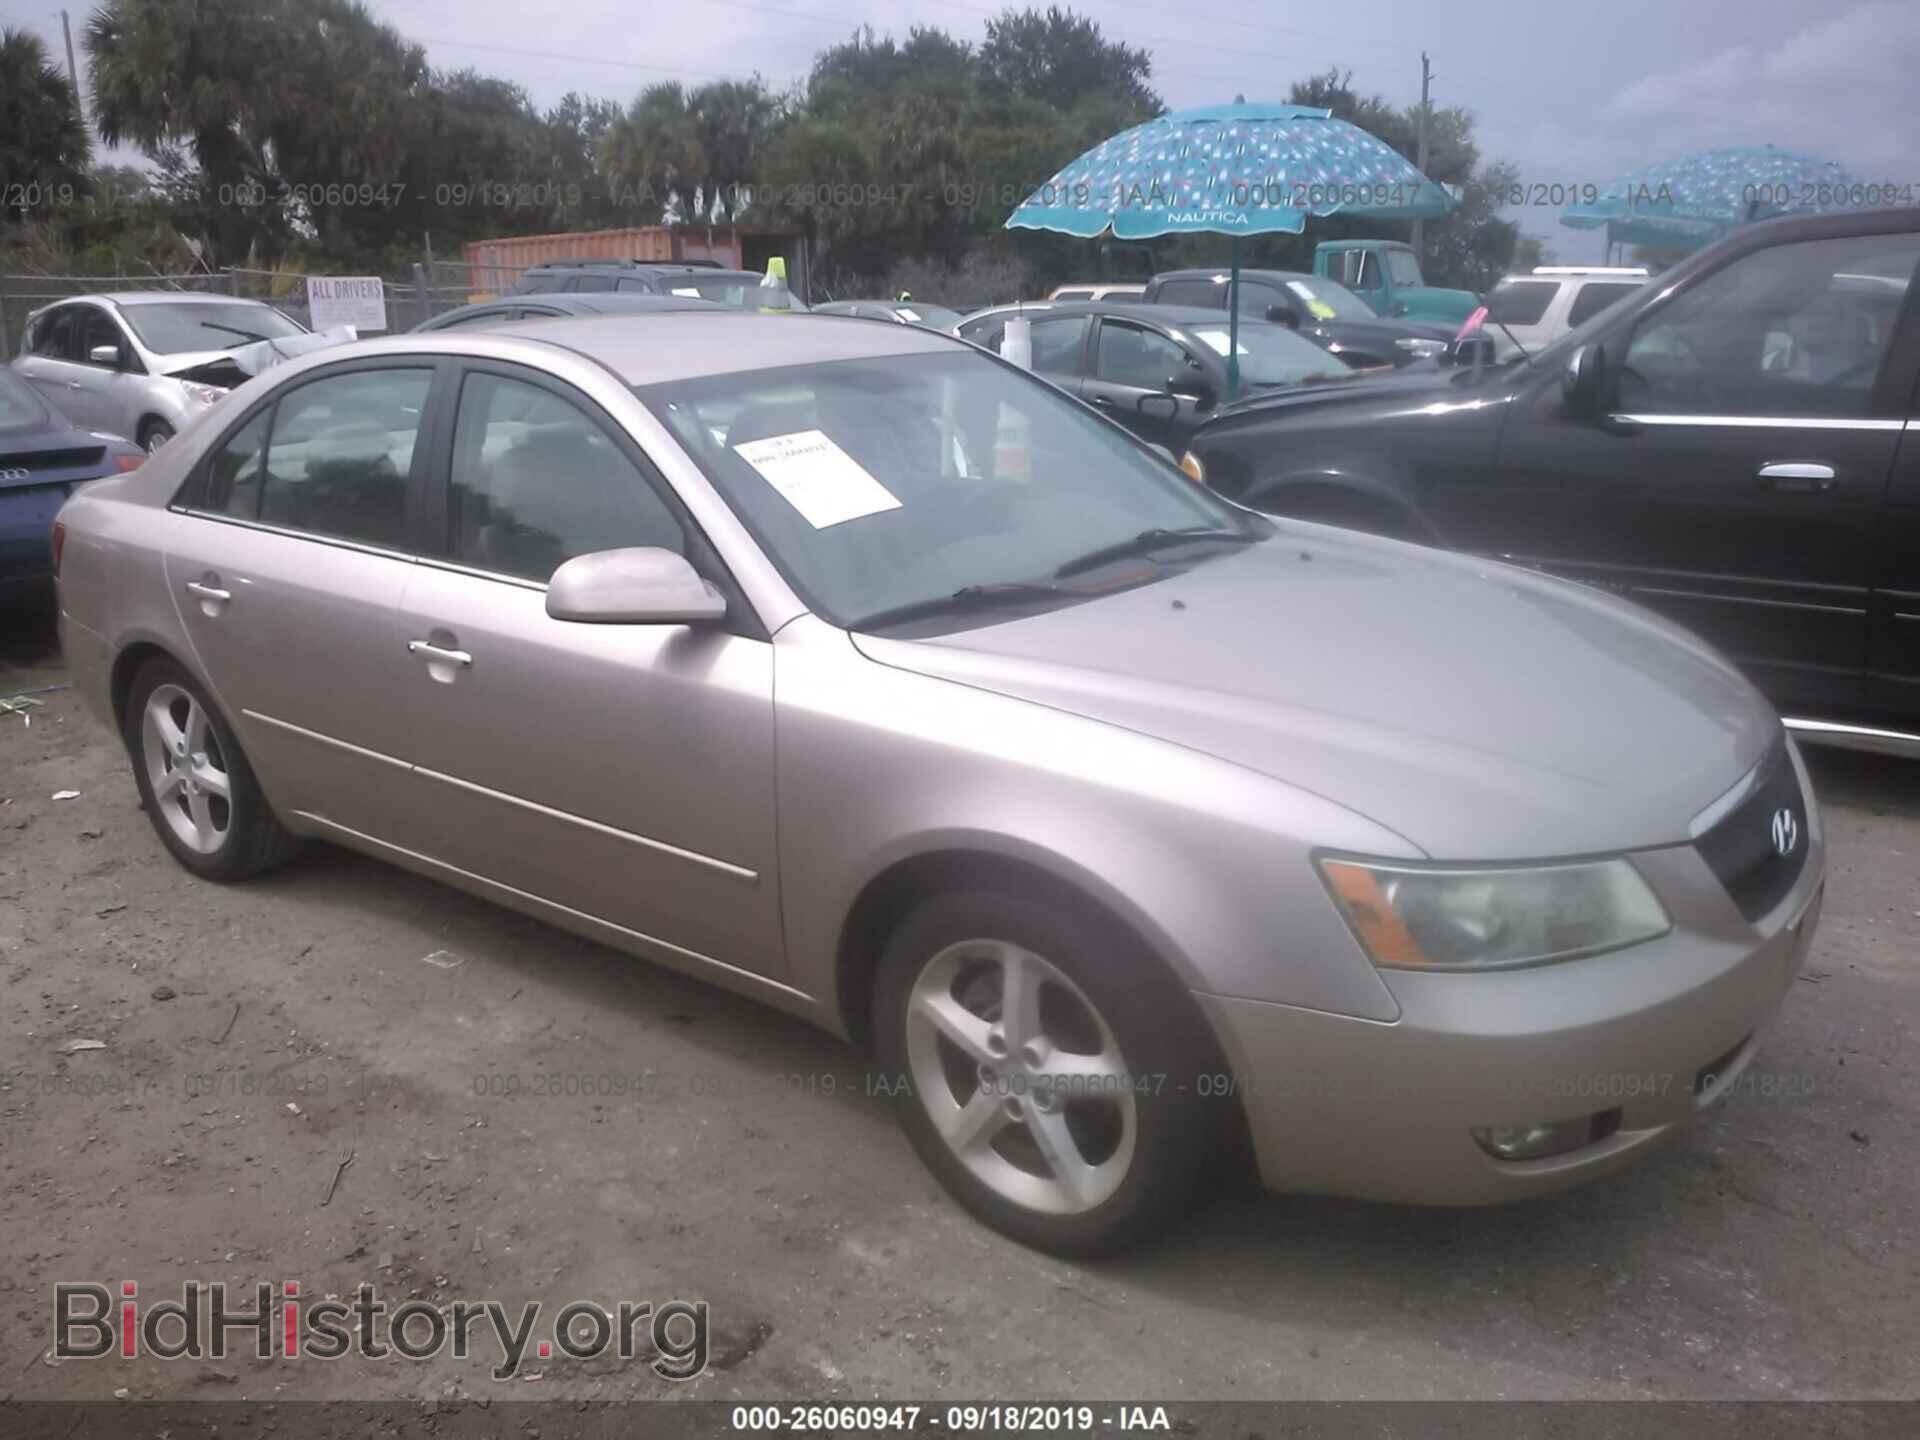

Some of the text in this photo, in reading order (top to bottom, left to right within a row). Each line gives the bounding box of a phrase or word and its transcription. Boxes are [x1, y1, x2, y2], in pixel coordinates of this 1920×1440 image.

[1167, 212, 1249, 225] NAUTICA
[312, 280, 381, 300] ALL DRIVERS
